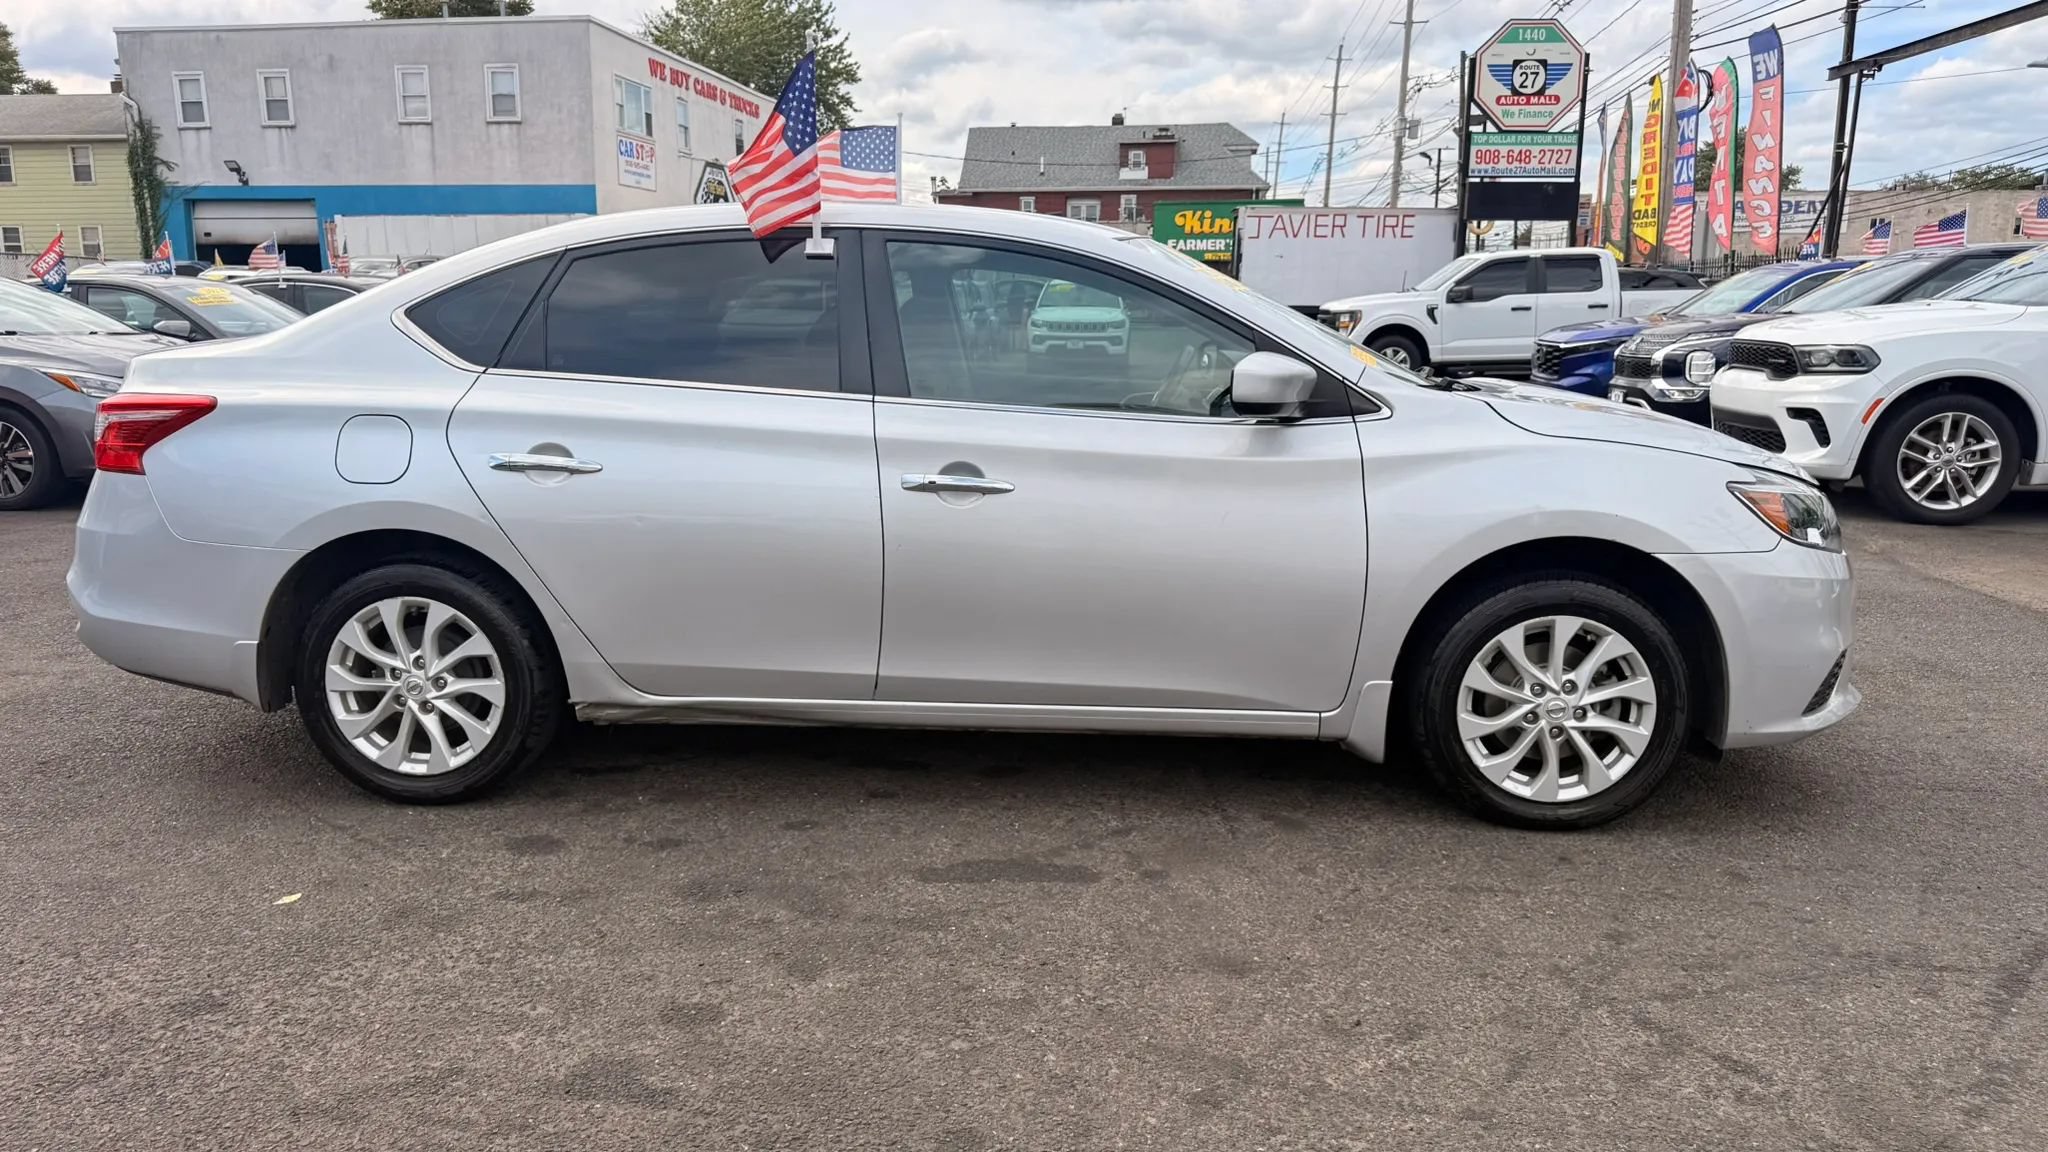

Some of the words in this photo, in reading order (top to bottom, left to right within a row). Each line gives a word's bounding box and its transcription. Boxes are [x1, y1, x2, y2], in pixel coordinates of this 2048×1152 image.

[1518, 29, 1546, 41] 1440
[648, 57, 667, 82] WE
[669, 67, 691, 91] BUY
[693, 77, 718, 102] CARS
[719, 88, 728, 106] &
[728, 91, 760, 119] TRUCKS
[1518, 72, 1540, 89] 27
[1499, 96, 1527, 104] AUTO
[1530, 95, 1557, 104] MALL
[1501, 109, 1516, 119] We
[1517, 109, 1554, 119] Finance
[1474, 135, 1487, 144] TOP
[1489, 135, 1515, 144] DOLLAR
[1517, 135, 1531, 144] FOR
[1533, 135, 1553, 144] YOUR
[1554, 135, 1577, 144] TRADE
[619, 139, 635, 161] CAR
[1475, 149, 1572, 165] 908-648-2727
[1471, 166, 1575, 175] www.Route27AutoMall.com
[1175, 210, 1234, 234] Kin
[1247, 213, 1348, 239] JAVIER
[1357, 214, 1416, 239] TIRE
